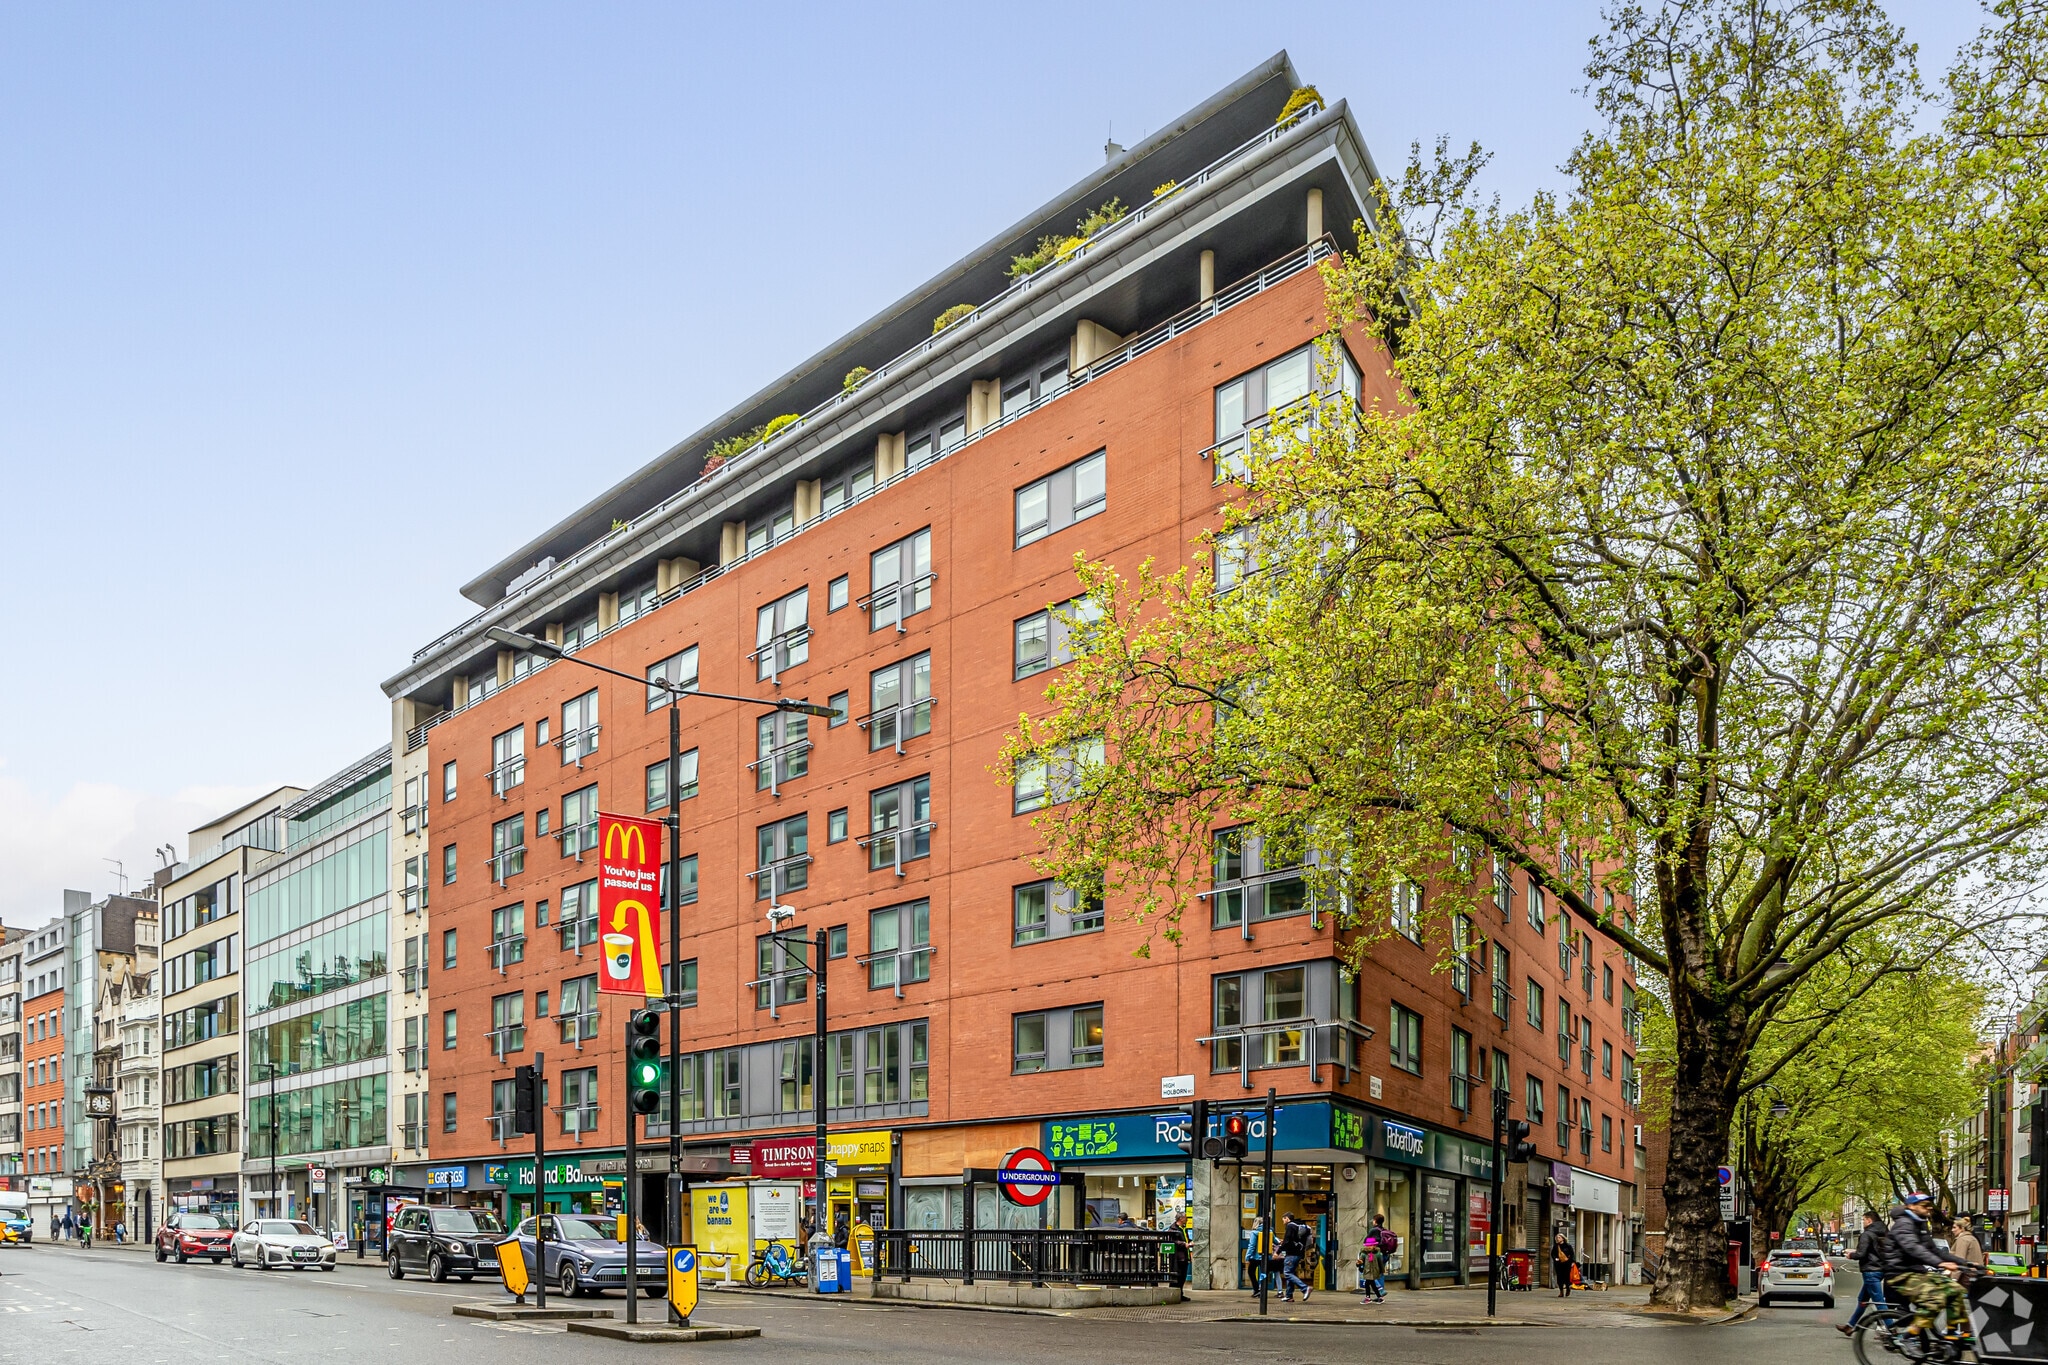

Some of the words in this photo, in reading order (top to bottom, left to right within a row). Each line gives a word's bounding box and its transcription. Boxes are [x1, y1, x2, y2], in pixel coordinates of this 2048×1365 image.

[604, 864, 636, 878] You've
[637, 868, 656, 881] just
[604, 877, 639, 890] passed
[640, 882, 653, 892] us
[1163, 1088, 1188, 1096] HOLBORN
[1386, 1125, 1409, 1151] Robert
[1408, 1132, 1424, 1158] Dyas
[761, 1146, 815, 1162] TIMPSON
[434, 1170, 463, 1184] GREGGS
[1002, 1172, 1056, 1182] UNDERGROUND
[708, 1195, 716, 1203] we
[709, 1206, 719, 1214] are
[707, 1215, 732, 1225] bananas
